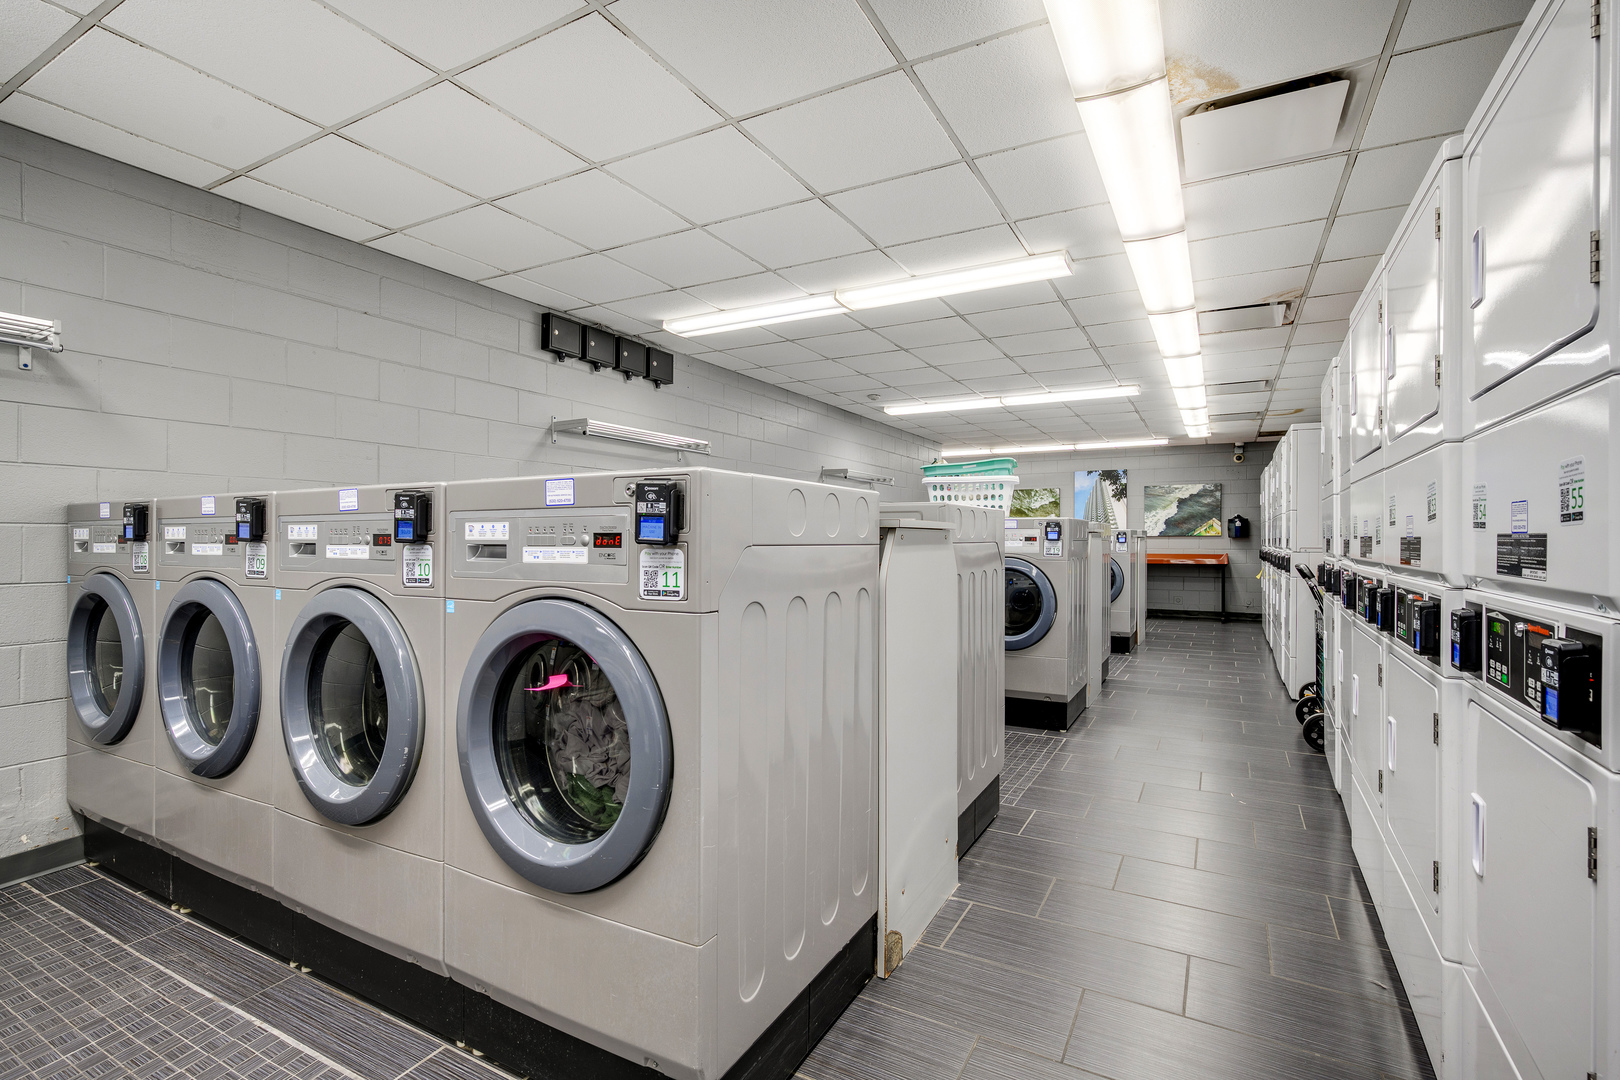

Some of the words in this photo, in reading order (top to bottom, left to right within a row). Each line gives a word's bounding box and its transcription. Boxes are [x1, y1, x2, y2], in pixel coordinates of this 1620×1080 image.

[1572, 486, 1584, 509] 55
[1479, 504, 1486, 520] 54
[140, 554, 147, 565] 08
[256, 558, 265, 569] 09
[418, 563, 430, 576] 10
[662, 572, 680, 588] 11
